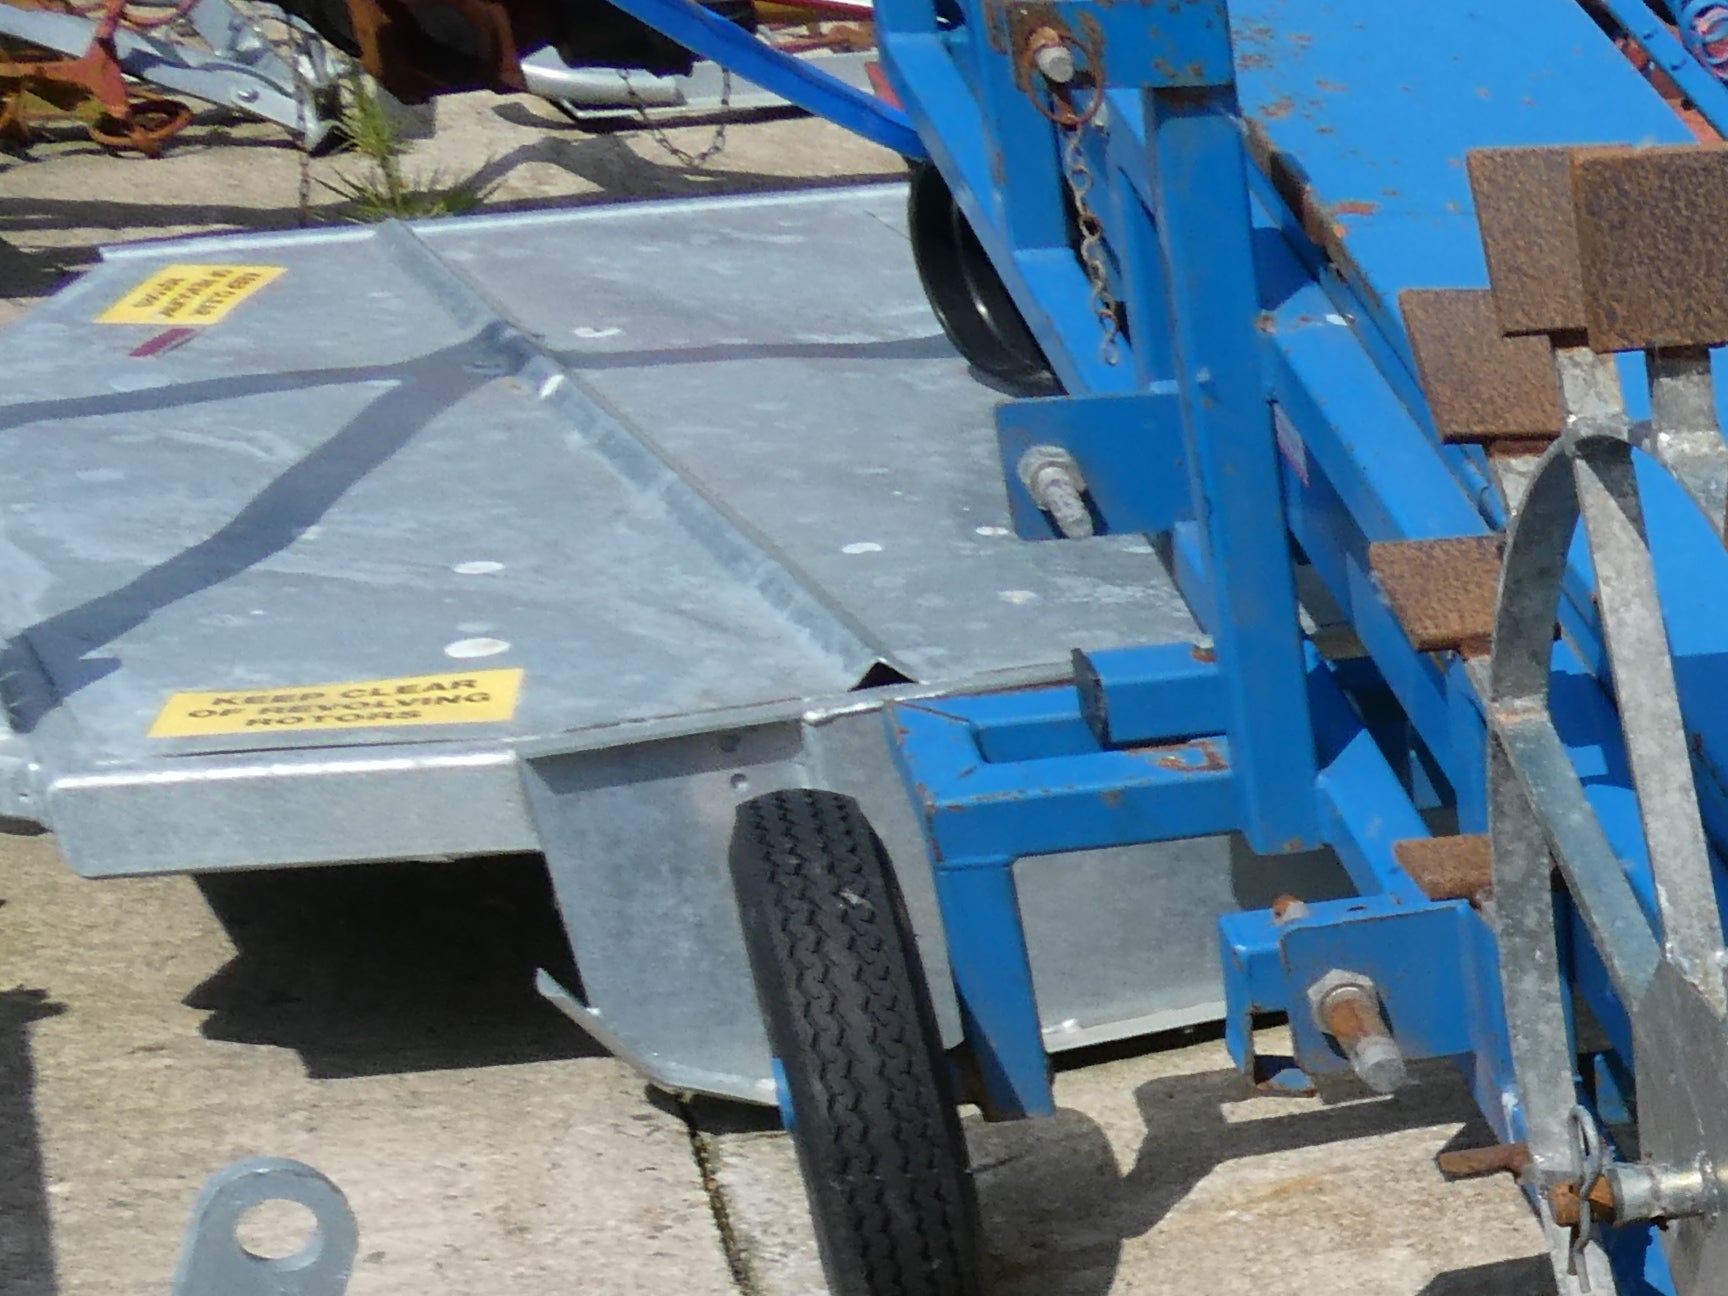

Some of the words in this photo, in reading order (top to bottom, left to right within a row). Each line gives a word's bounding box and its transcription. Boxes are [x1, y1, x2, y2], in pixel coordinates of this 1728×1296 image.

[187, 706, 245, 719] OF
[257, 691, 492, 716] REVOLVING
[211, 690, 326, 707] KEEP
[340, 678, 479, 698] CLEAR
[244, 709, 423, 728] ROTORS
